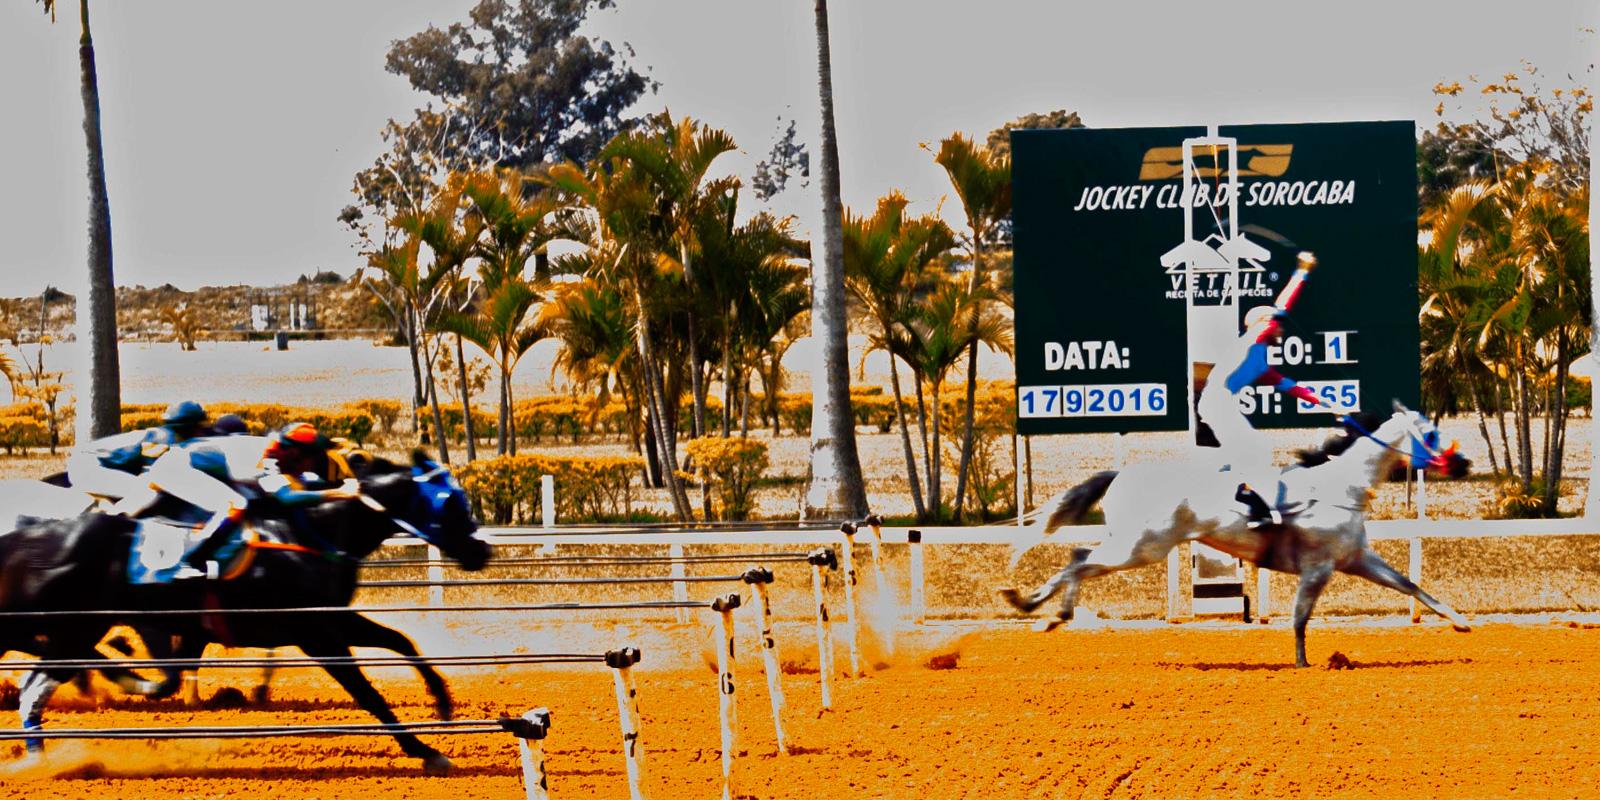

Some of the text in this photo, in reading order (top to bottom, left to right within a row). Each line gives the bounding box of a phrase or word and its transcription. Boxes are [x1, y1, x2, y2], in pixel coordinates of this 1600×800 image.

[1074, 185, 1154, 211] JOCKEY
[1245, 180, 1355, 206] SOROCABA
[1165, 290, 1204, 299] RECTA
[1207, 289, 1219, 298] DE
[1044, 341, 1130, 371] DATA:
[1266, 336, 1341, 365] EO: 1
[1022, 388, 1165, 414] 17 9 2016
[1239, 385, 1282, 414] ST:
